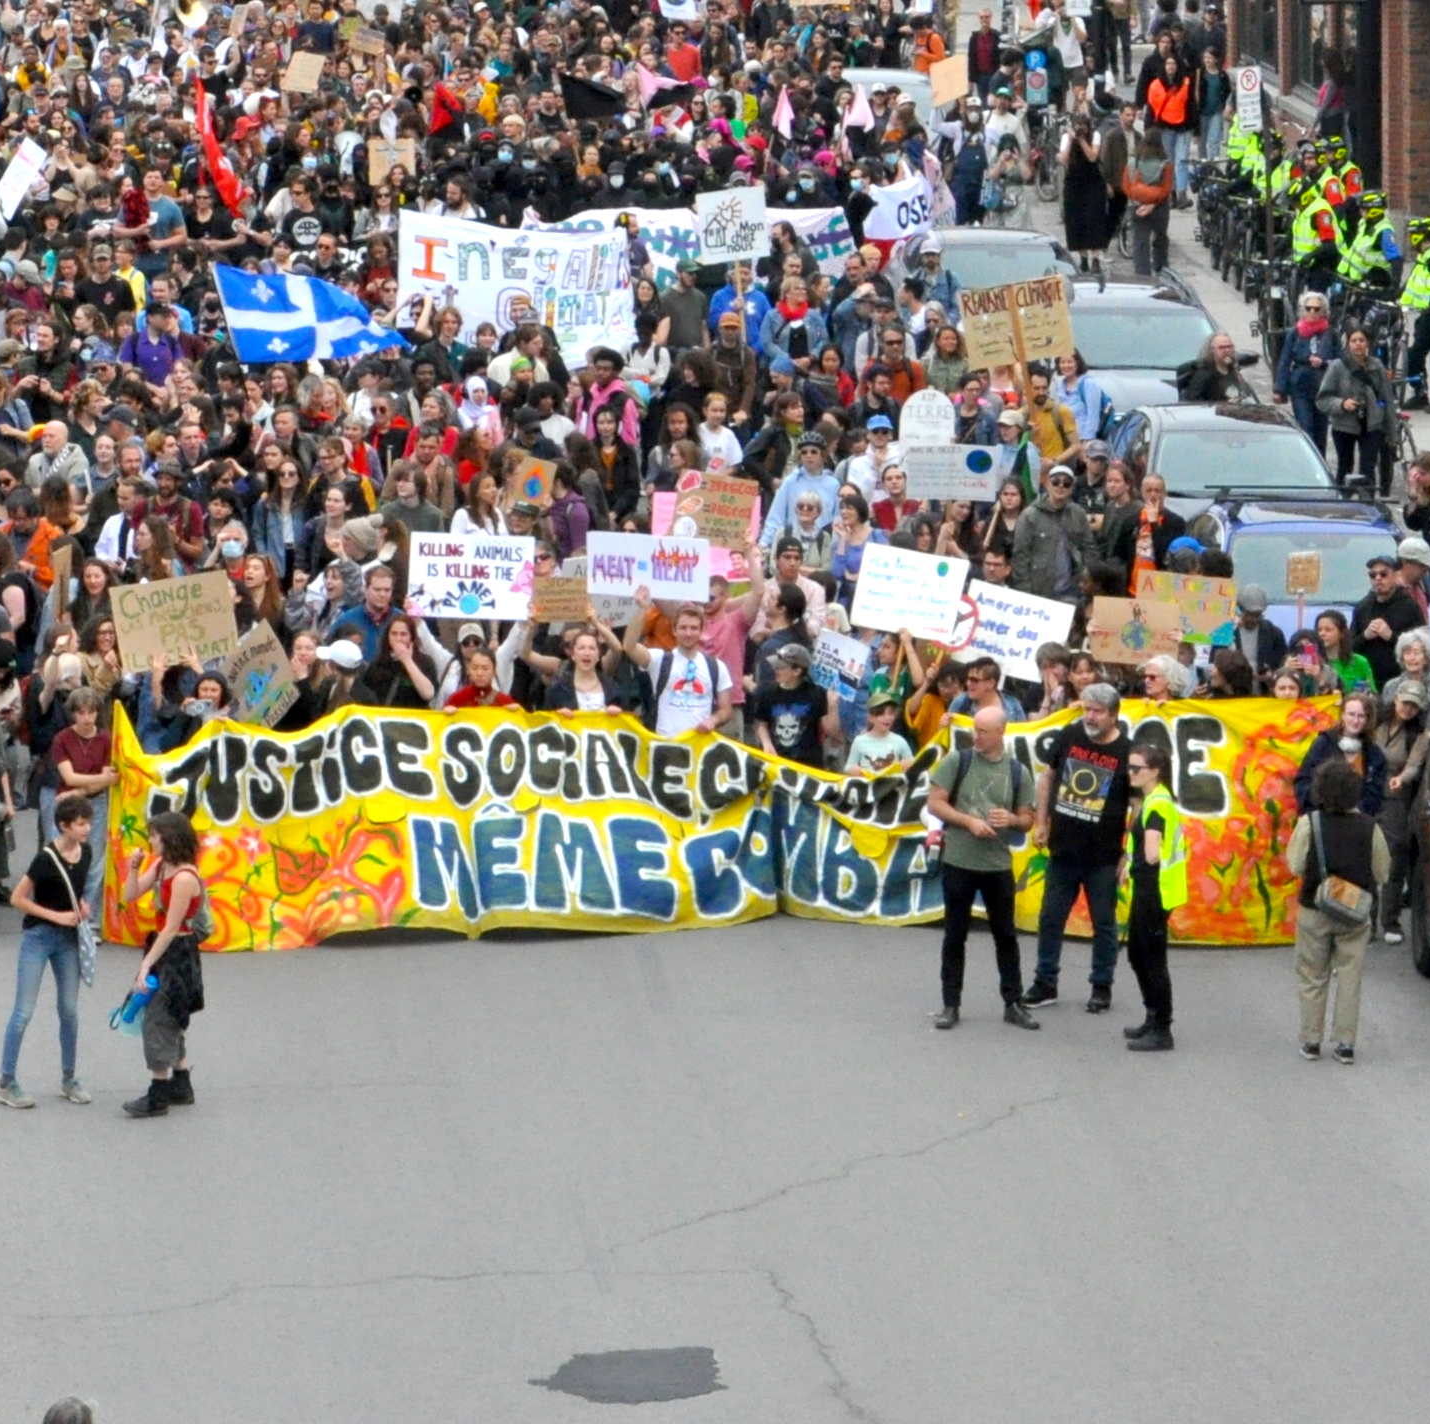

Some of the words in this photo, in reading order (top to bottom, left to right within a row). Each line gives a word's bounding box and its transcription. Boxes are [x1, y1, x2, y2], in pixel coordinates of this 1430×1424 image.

[739, 220, 765, 233] Mon
[725, 240, 755, 252] nous
[730, 230, 758, 246] chez
[906, 404, 952, 420] TERRE
[418, 541, 465, 557] KILLING
[473, 545, 524, 563] ANIMALS
[427, 562, 439, 577] IS
[445, 562, 491, 580] KILLING
[494, 565, 515, 581] THE
[592, 554, 635, 584] MEAT
[118, 581, 203, 621] Change
[441, 580, 496, 610] PLANET
[410, 799, 680, 923] MÊME
[679, 786, 981, 919] COMBA
